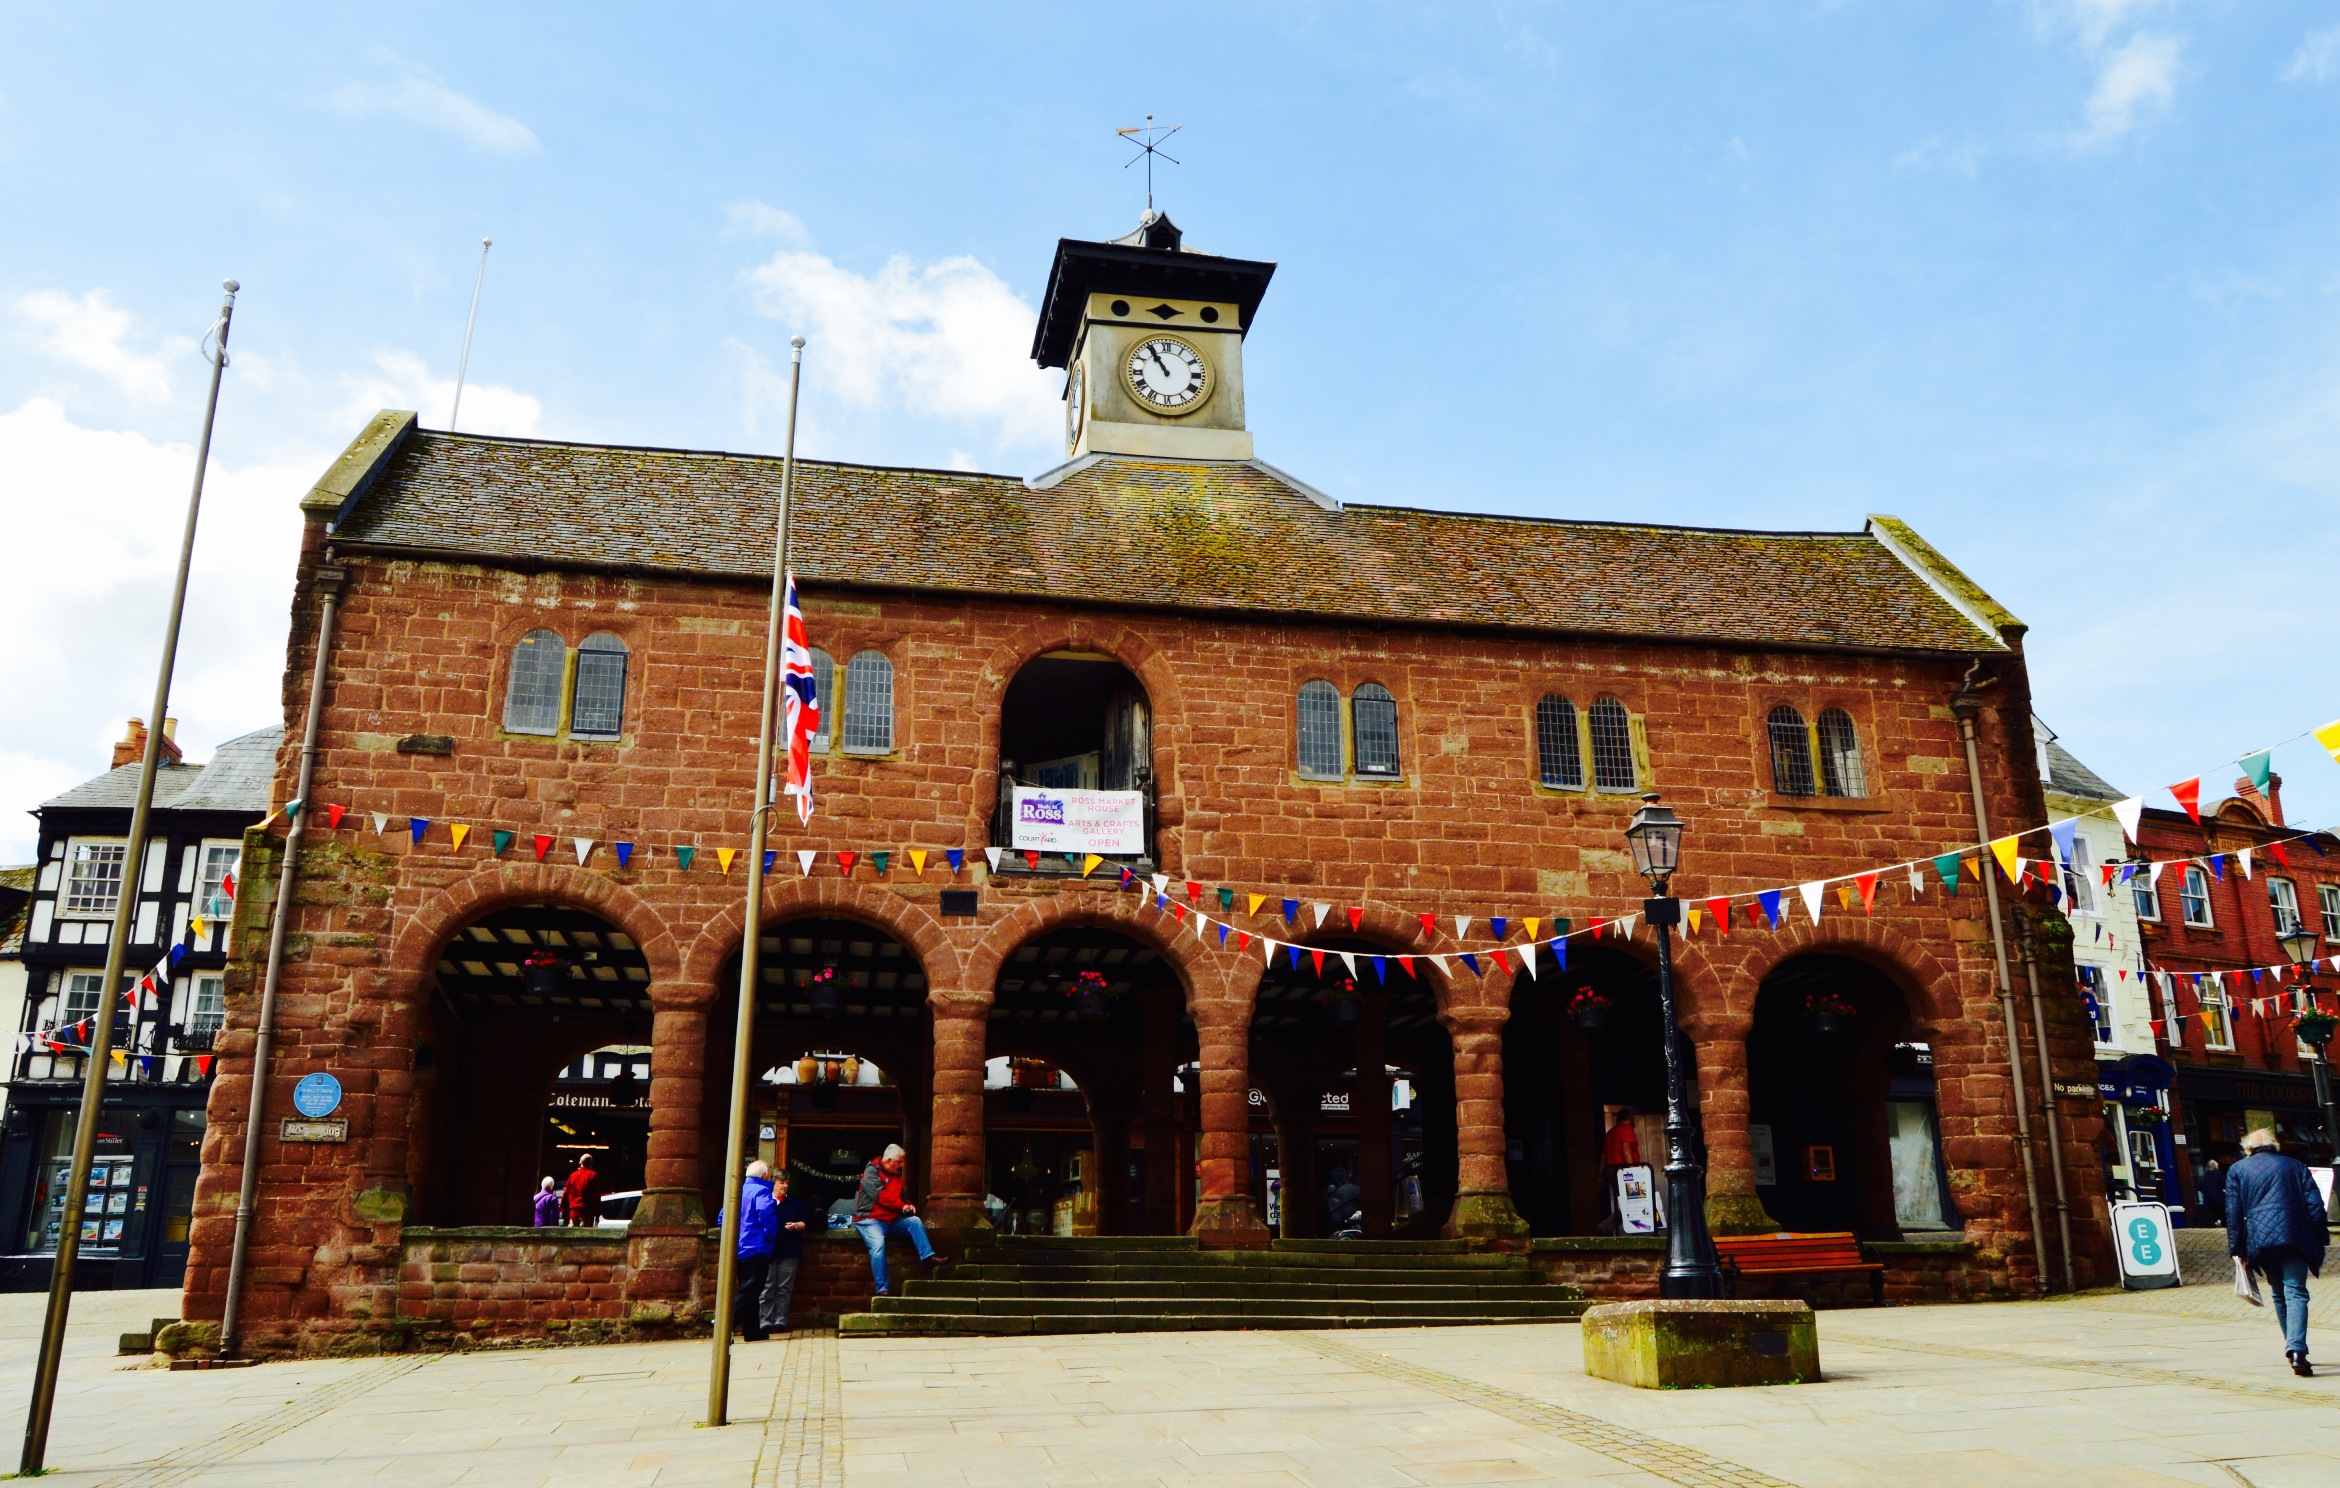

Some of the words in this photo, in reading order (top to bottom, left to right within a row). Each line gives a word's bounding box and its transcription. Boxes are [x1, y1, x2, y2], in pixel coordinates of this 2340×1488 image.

[1023, 804, 1062, 820] Ross
[1103, 820, 1139, 828] CRAFTS
[1088, 839, 1120, 847] OPEN
[2054, 1083, 2065, 1092] No
[2235, 1083, 2259, 1099] THE
